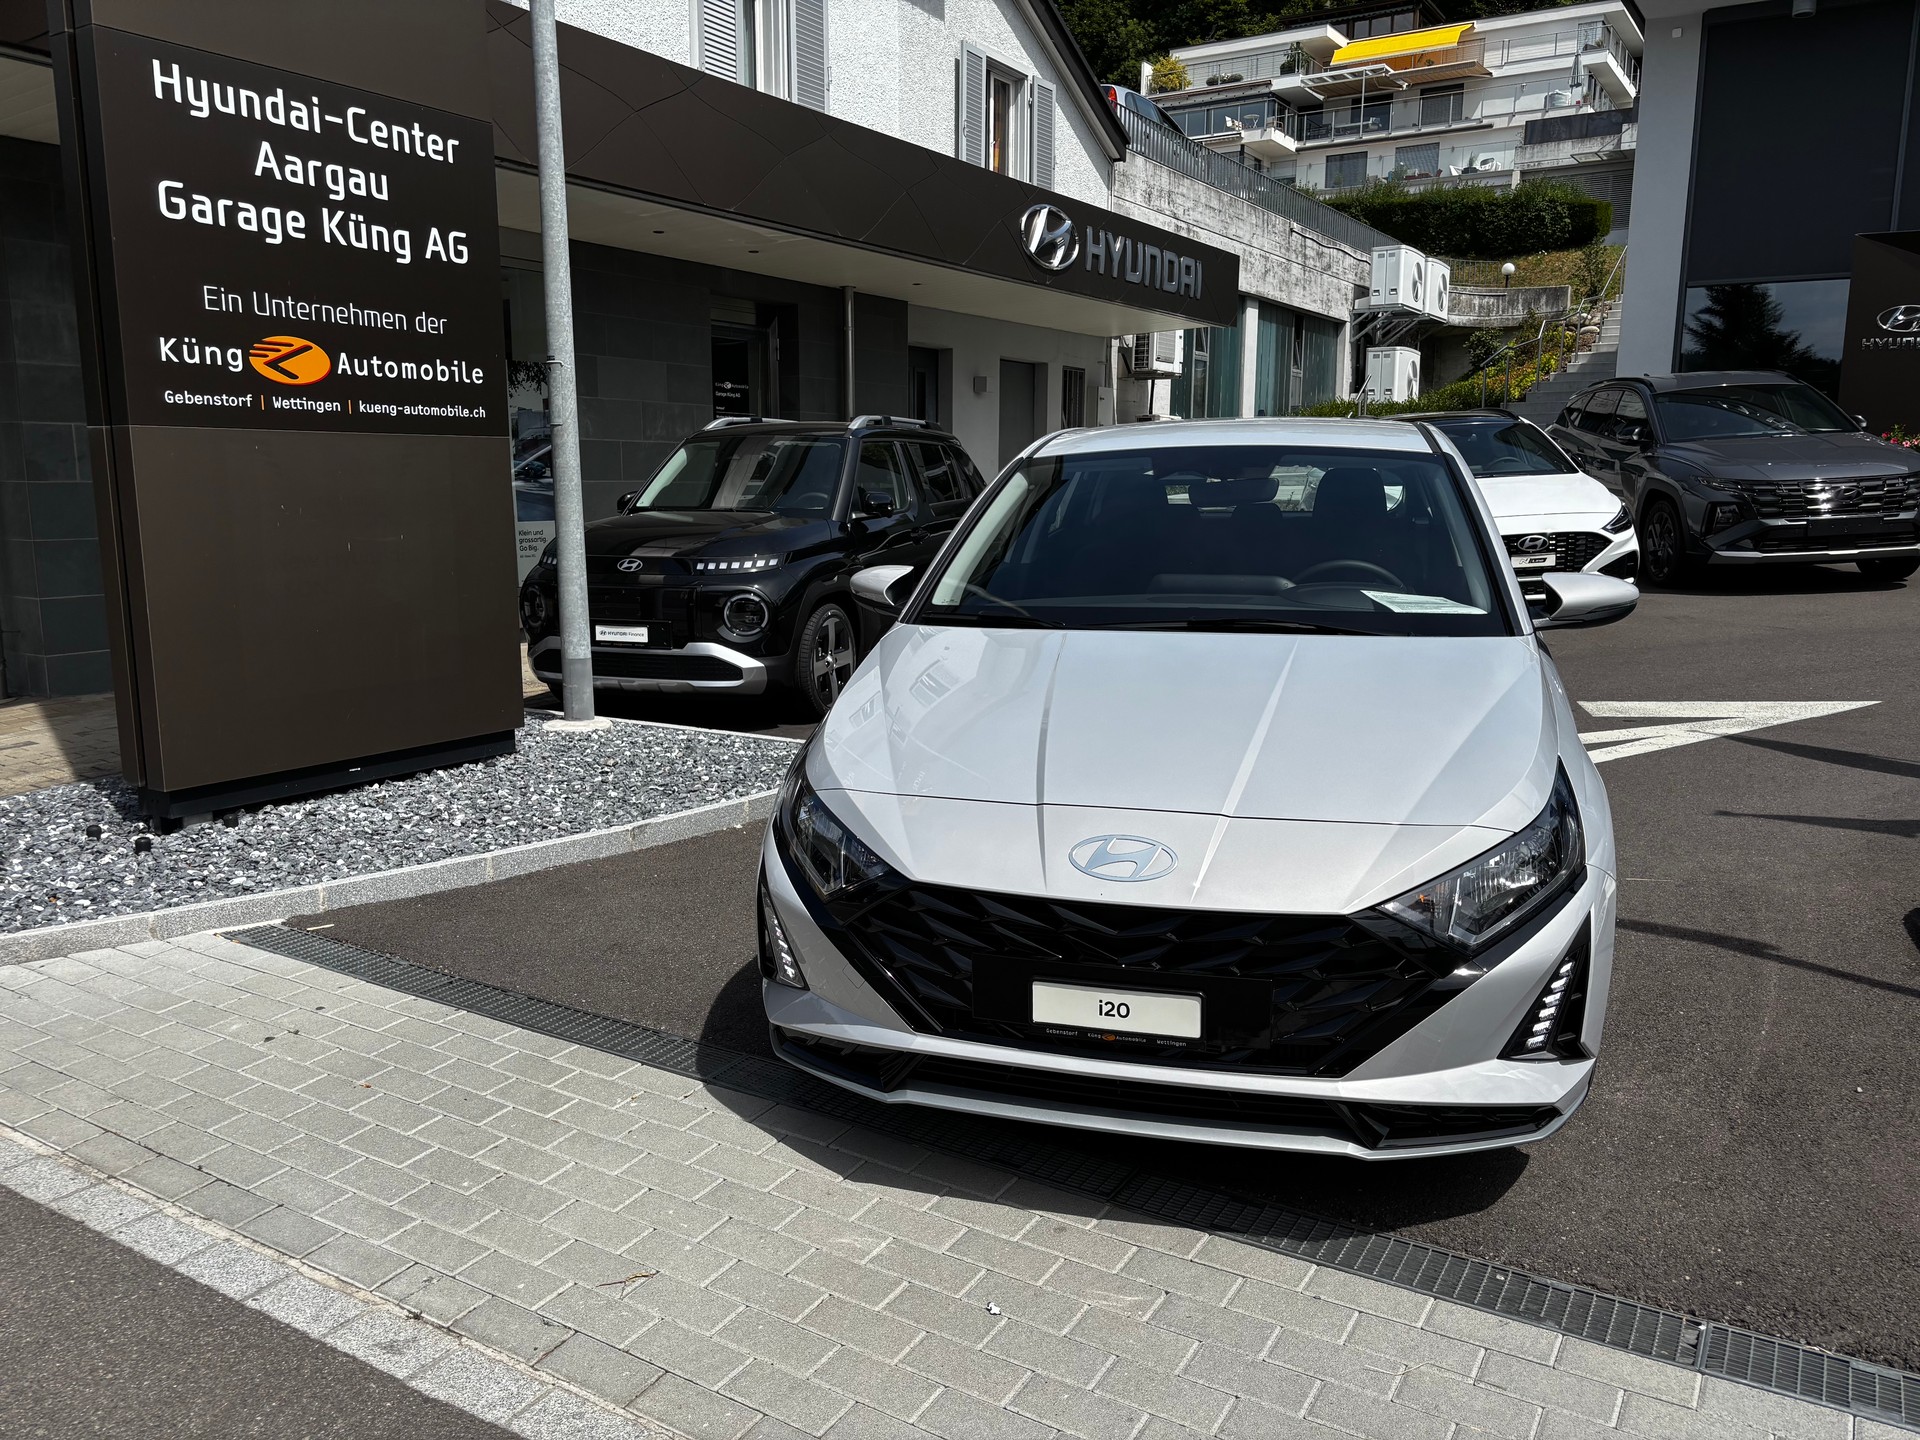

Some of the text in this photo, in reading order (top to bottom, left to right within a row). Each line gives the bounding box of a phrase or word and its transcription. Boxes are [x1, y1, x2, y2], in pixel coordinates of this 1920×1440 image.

[151, 57, 460, 165] Hyundai-Center
[254, 140, 389, 202] Aargau
[157, 179, 470, 265] Garage Küng AG
[1085, 225, 1203, 300] HYUNDAI
[203, 284, 448, 335] Ein Unternehmen der
[158, 336, 485, 385] Küng Automobile
[163, 389, 487, 419] Gebenstorf Wettingen kueng-automobile.ch
[1098, 999, 1130, 1019] i20
[1045, 1027, 1079, 1037] Gebenstorf
[1156, 1038, 1187, 1047] Wettingen
